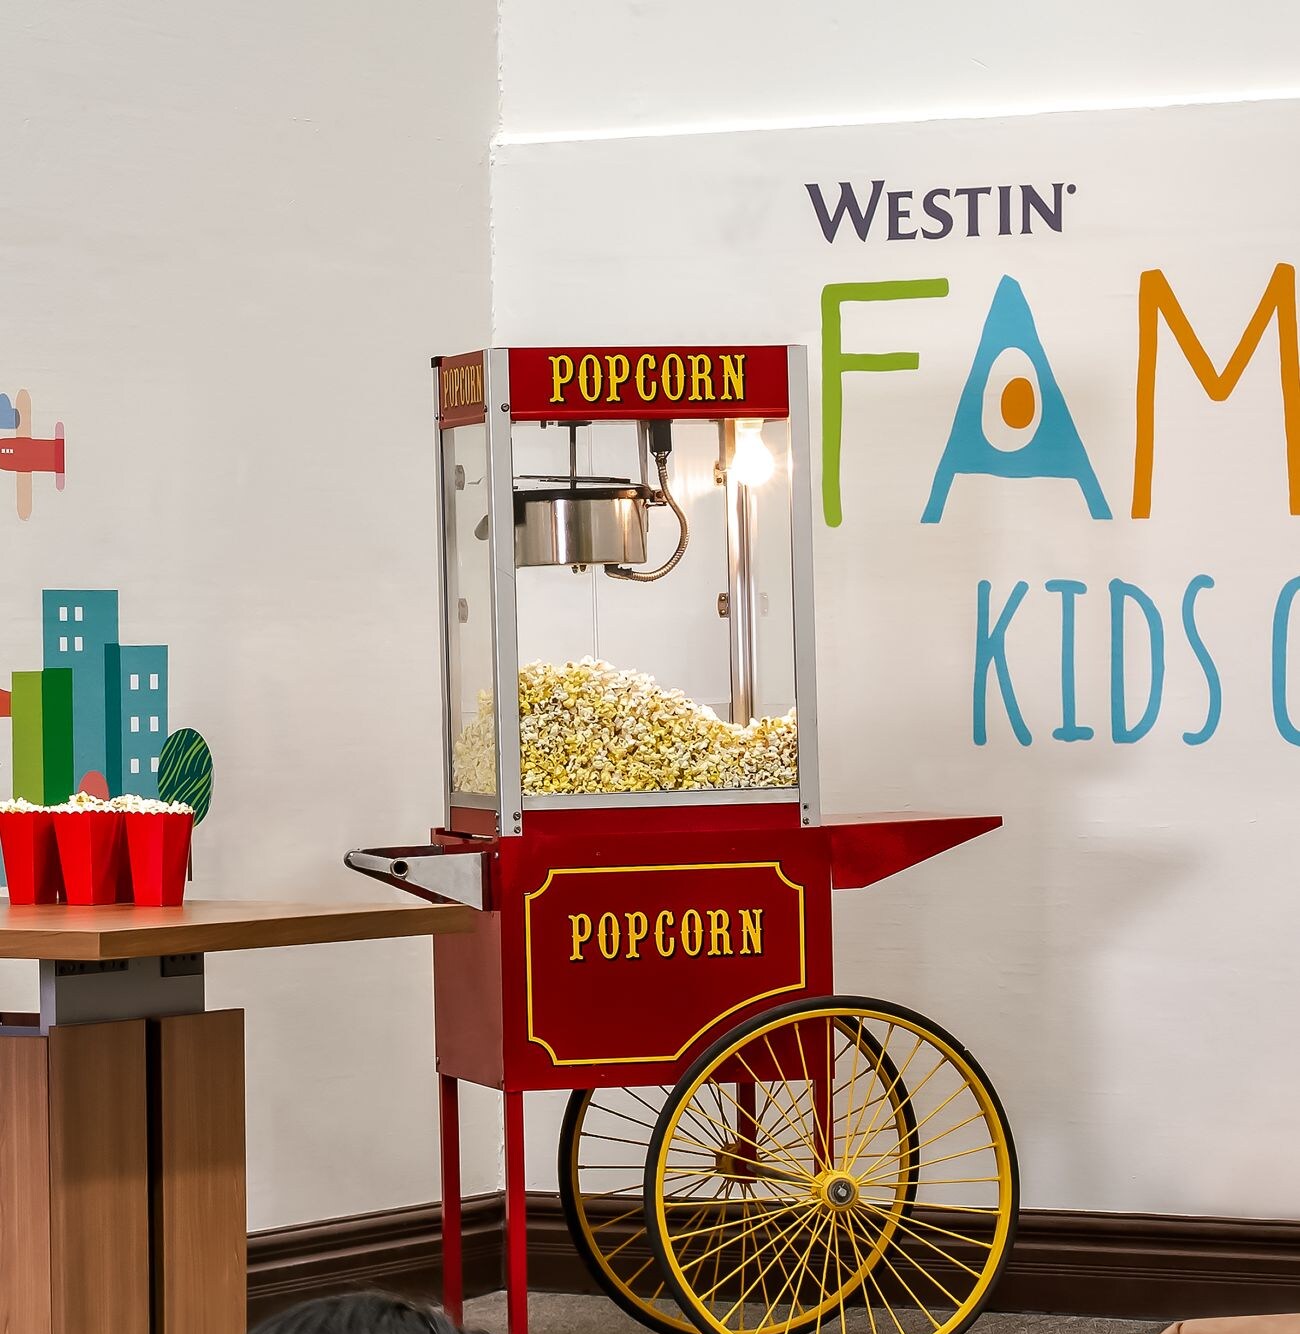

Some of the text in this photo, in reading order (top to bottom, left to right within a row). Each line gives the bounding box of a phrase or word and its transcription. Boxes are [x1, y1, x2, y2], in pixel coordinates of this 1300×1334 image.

[443, 364, 482, 409] POPCORN
[548, 354, 746, 402] POPCORN
[973, 574, 1222, 746] KIDS
[568, 908, 764, 961] POPCORN
